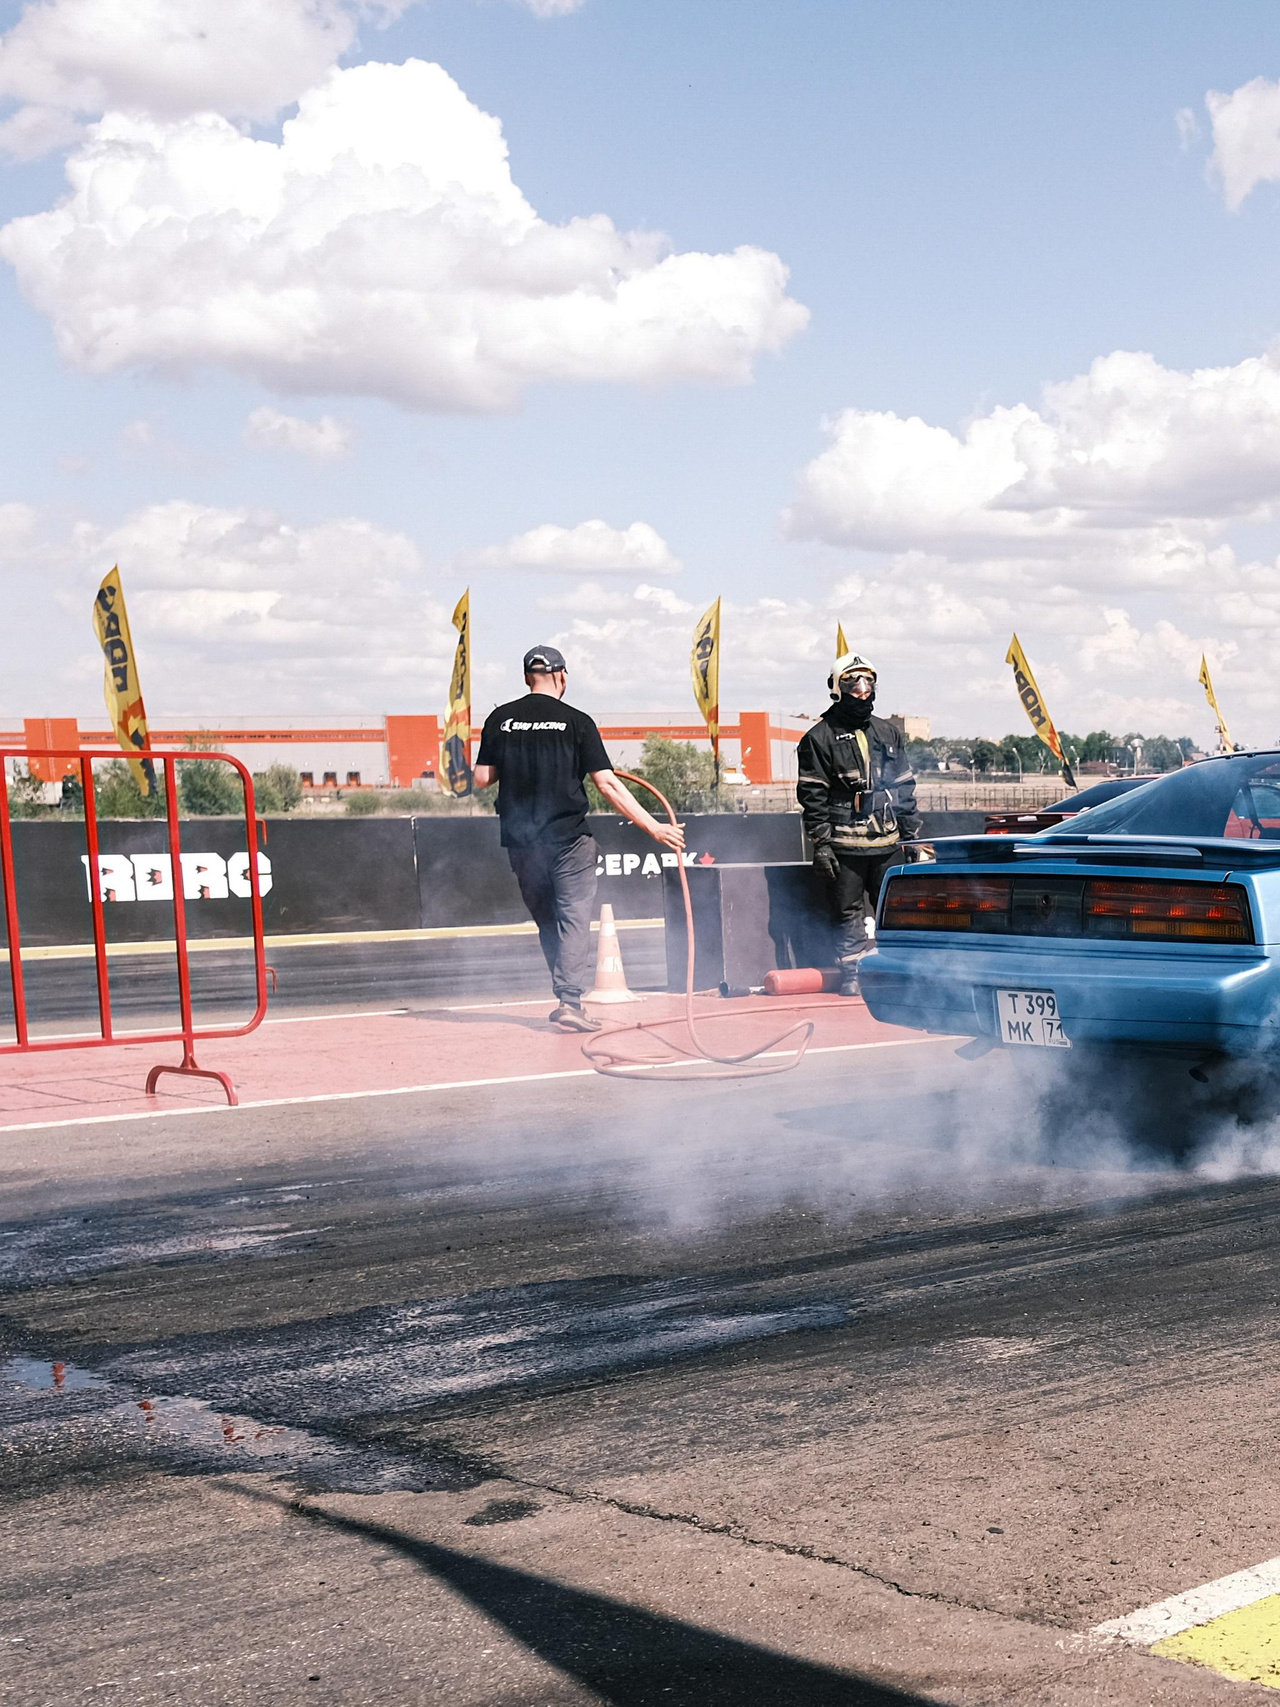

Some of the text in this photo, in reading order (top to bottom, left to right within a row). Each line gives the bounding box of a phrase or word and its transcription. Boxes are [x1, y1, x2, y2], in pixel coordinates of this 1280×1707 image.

[532, 721, 567, 732] RACING
[1007, 993, 1056, 1016] T 399
[1007, 1020, 1034, 1042] MK
